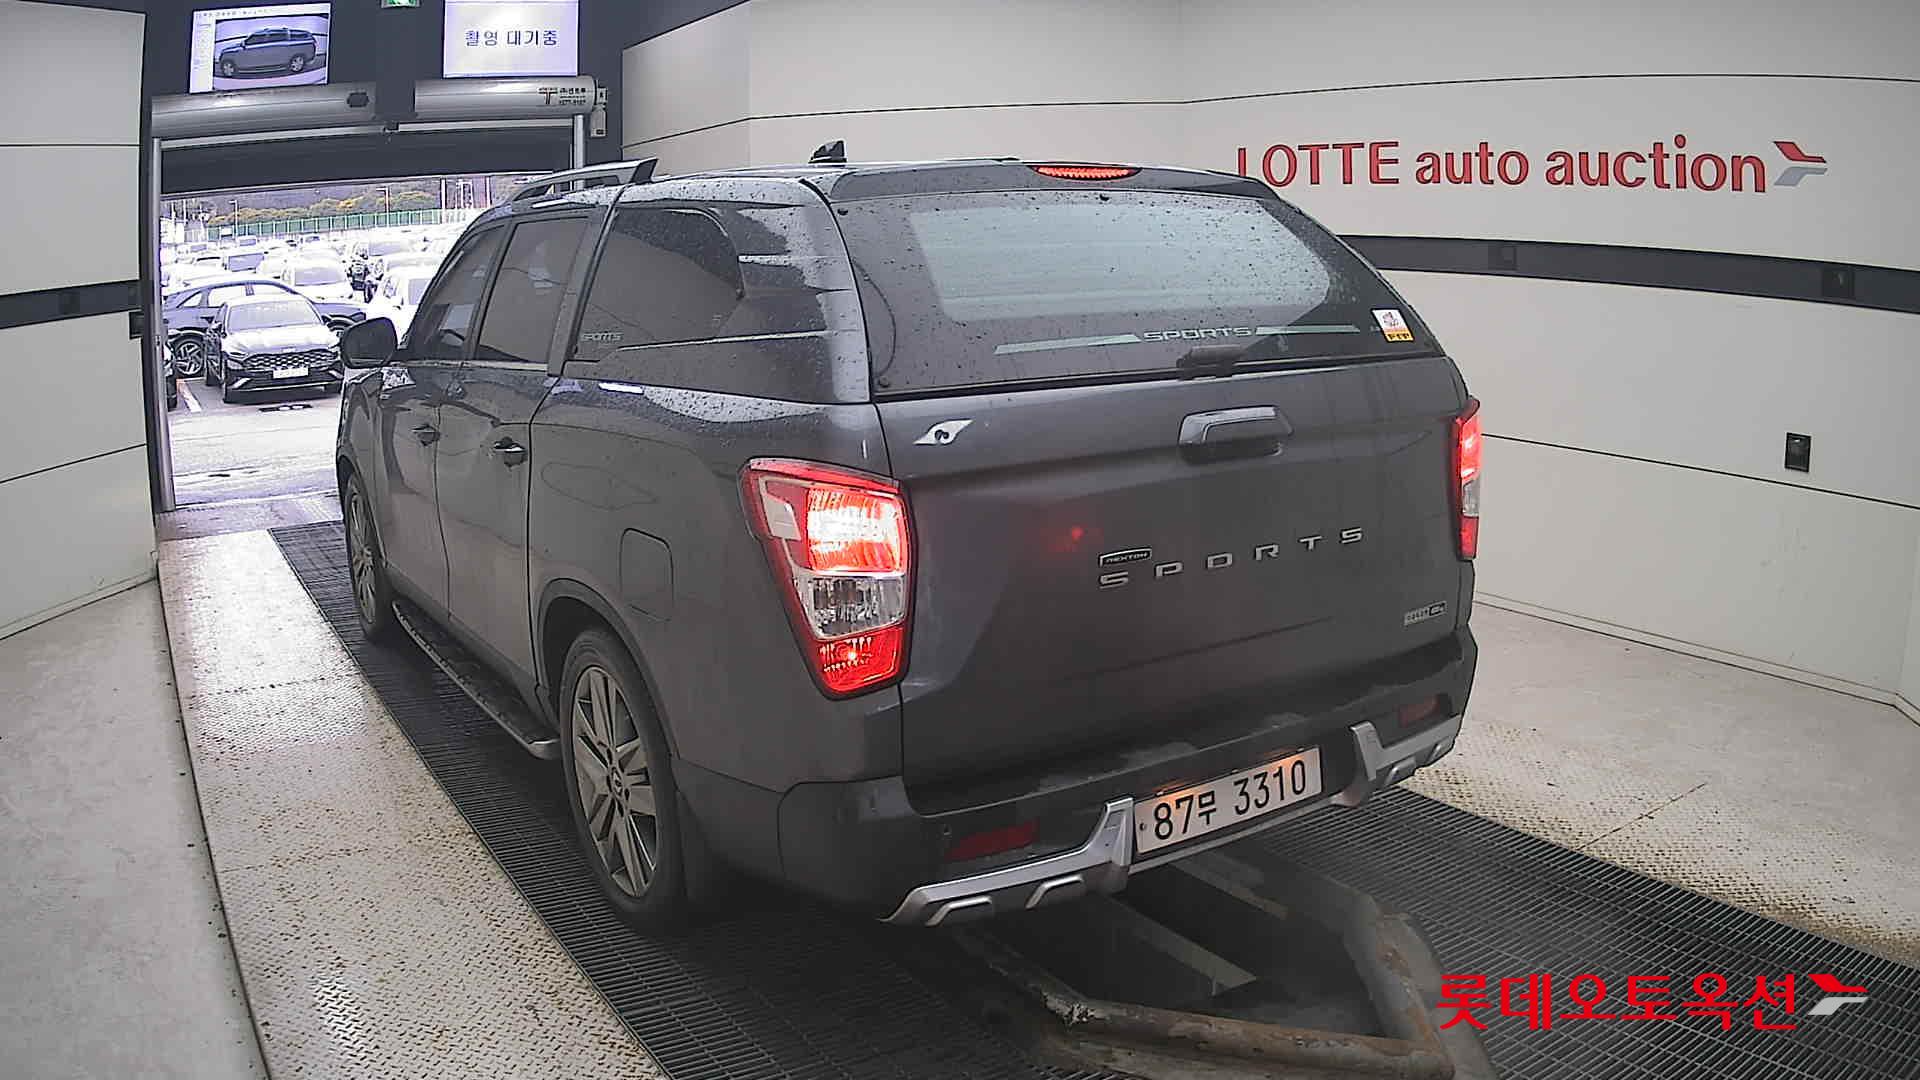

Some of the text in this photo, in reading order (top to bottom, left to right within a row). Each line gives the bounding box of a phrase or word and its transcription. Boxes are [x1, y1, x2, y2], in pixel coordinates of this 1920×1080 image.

[464, 29, 558, 47] 촬영 대기중
[1415, 142, 1530, 185] auto
[1545, 135, 1767, 194] auction
[1143, 326, 1253, 342] SPORTS
[1099, 527, 1363, 590] SPORTS
[1153, 759, 1307, 840] 87무 3310
